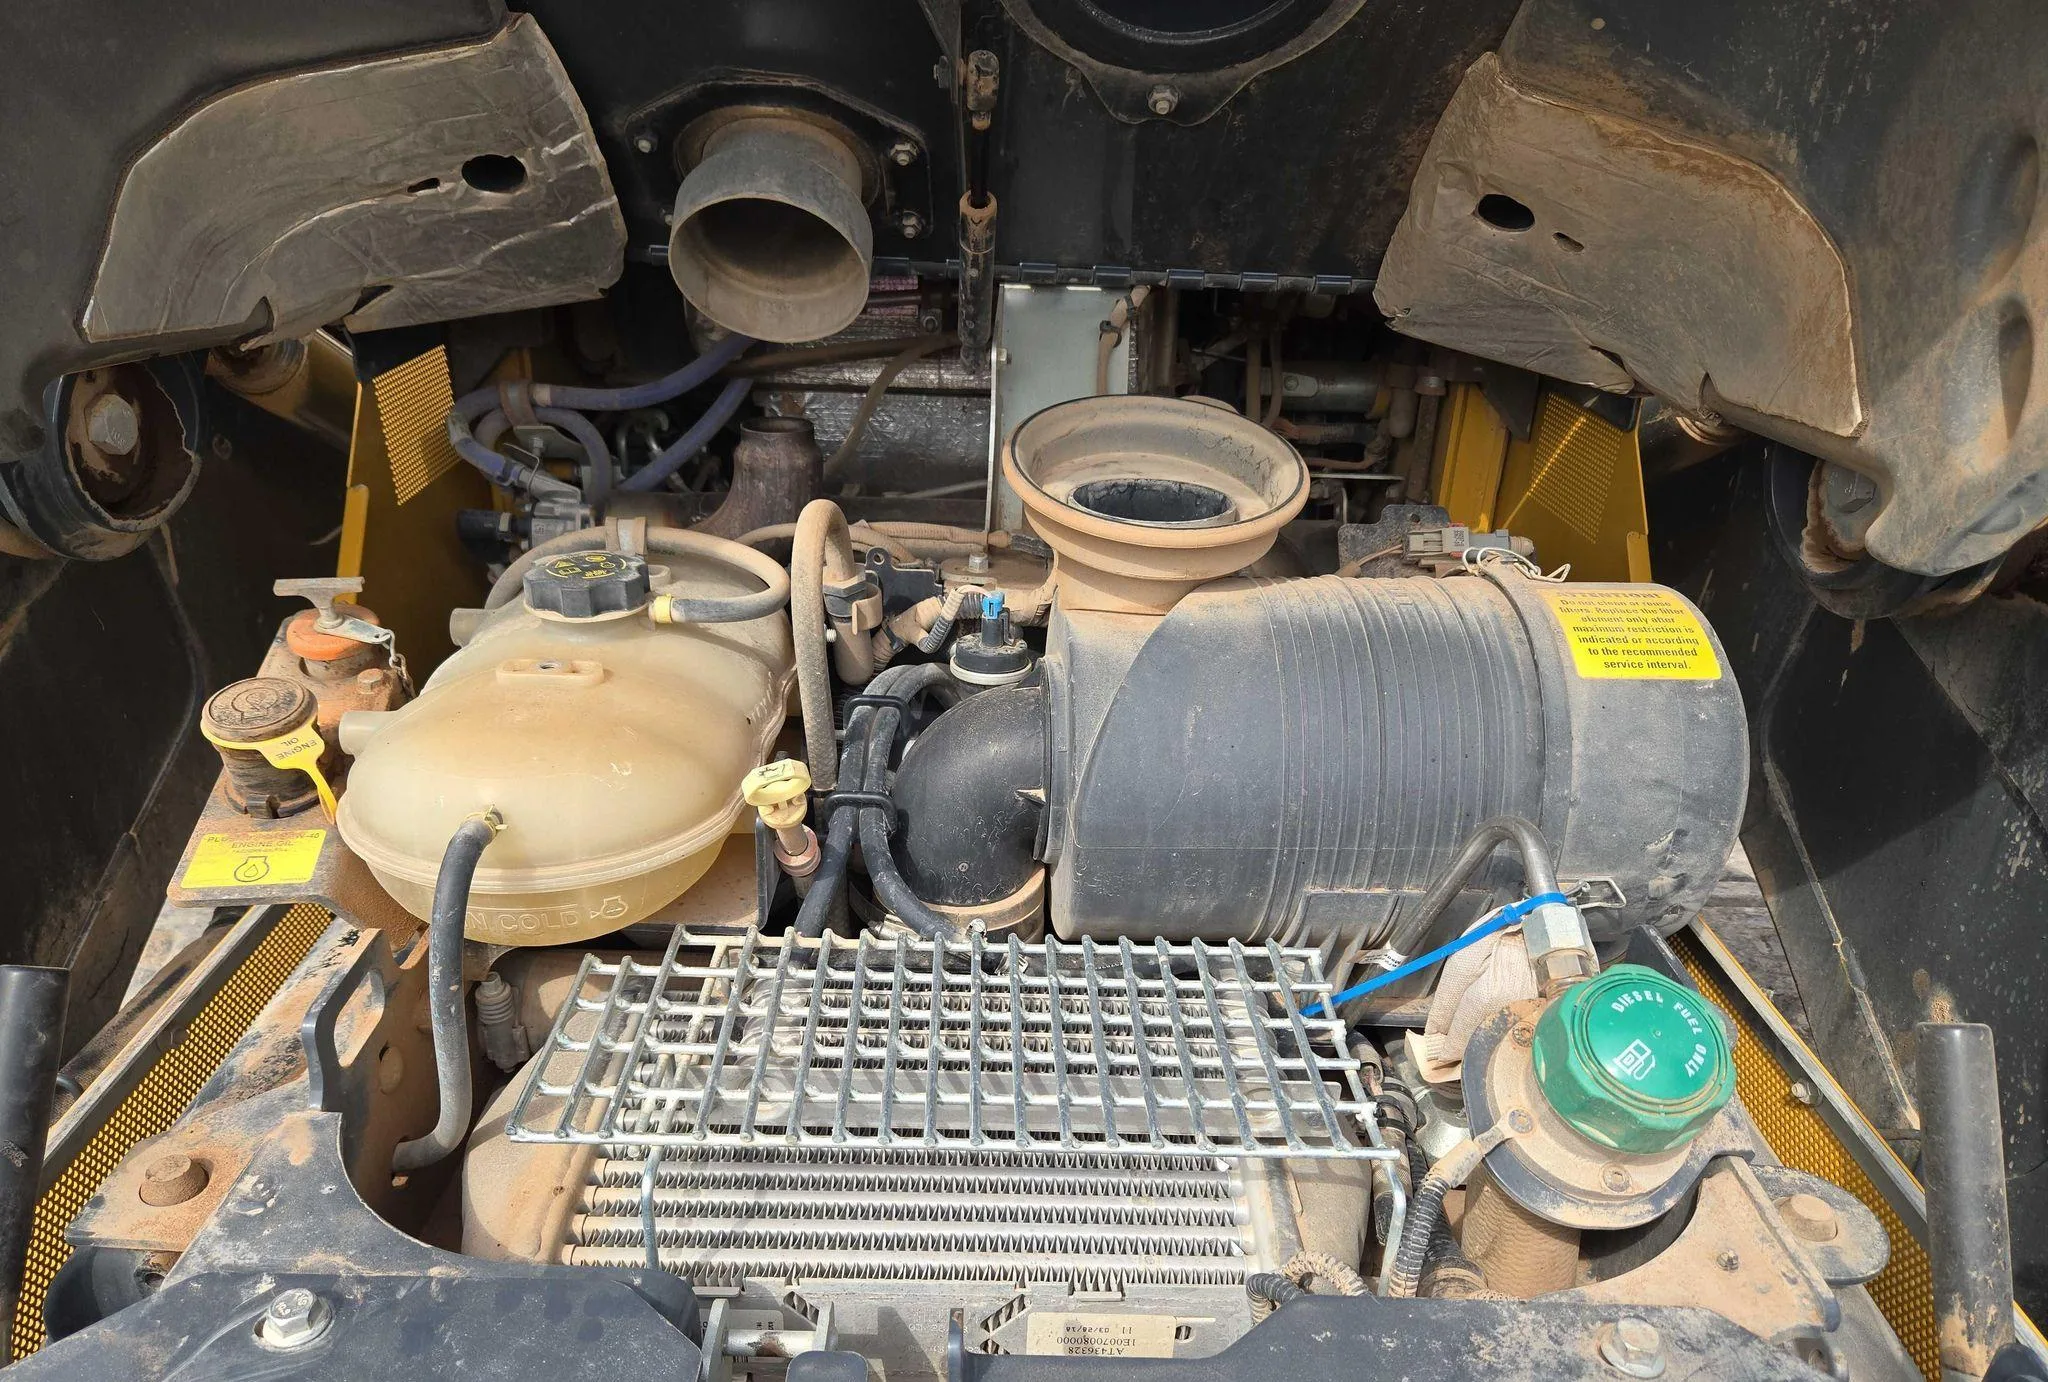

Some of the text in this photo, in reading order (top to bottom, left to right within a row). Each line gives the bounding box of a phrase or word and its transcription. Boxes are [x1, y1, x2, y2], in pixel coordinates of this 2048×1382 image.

[1595, 607, 1639, 615] Replace
[1626, 616, 1649, 625] only
[1573, 625, 1695, 634] maximum restriction is
[1578, 635, 1700, 647] indicated or according
[1588, 647, 1698, 657] to the recommended
[1604, 659, 1692, 670] service interval.
[280, 737, 300, 746] OIL
[276, 739, 319, 762] ENGINE
[231, 840, 273, 849] ENGINE
[498, 911, 578, 931] COLD
[1611, 990, 1707, 1078] DIESEL FUEL ONLY
[1068, 1347, 1125, 1355] AT436328
